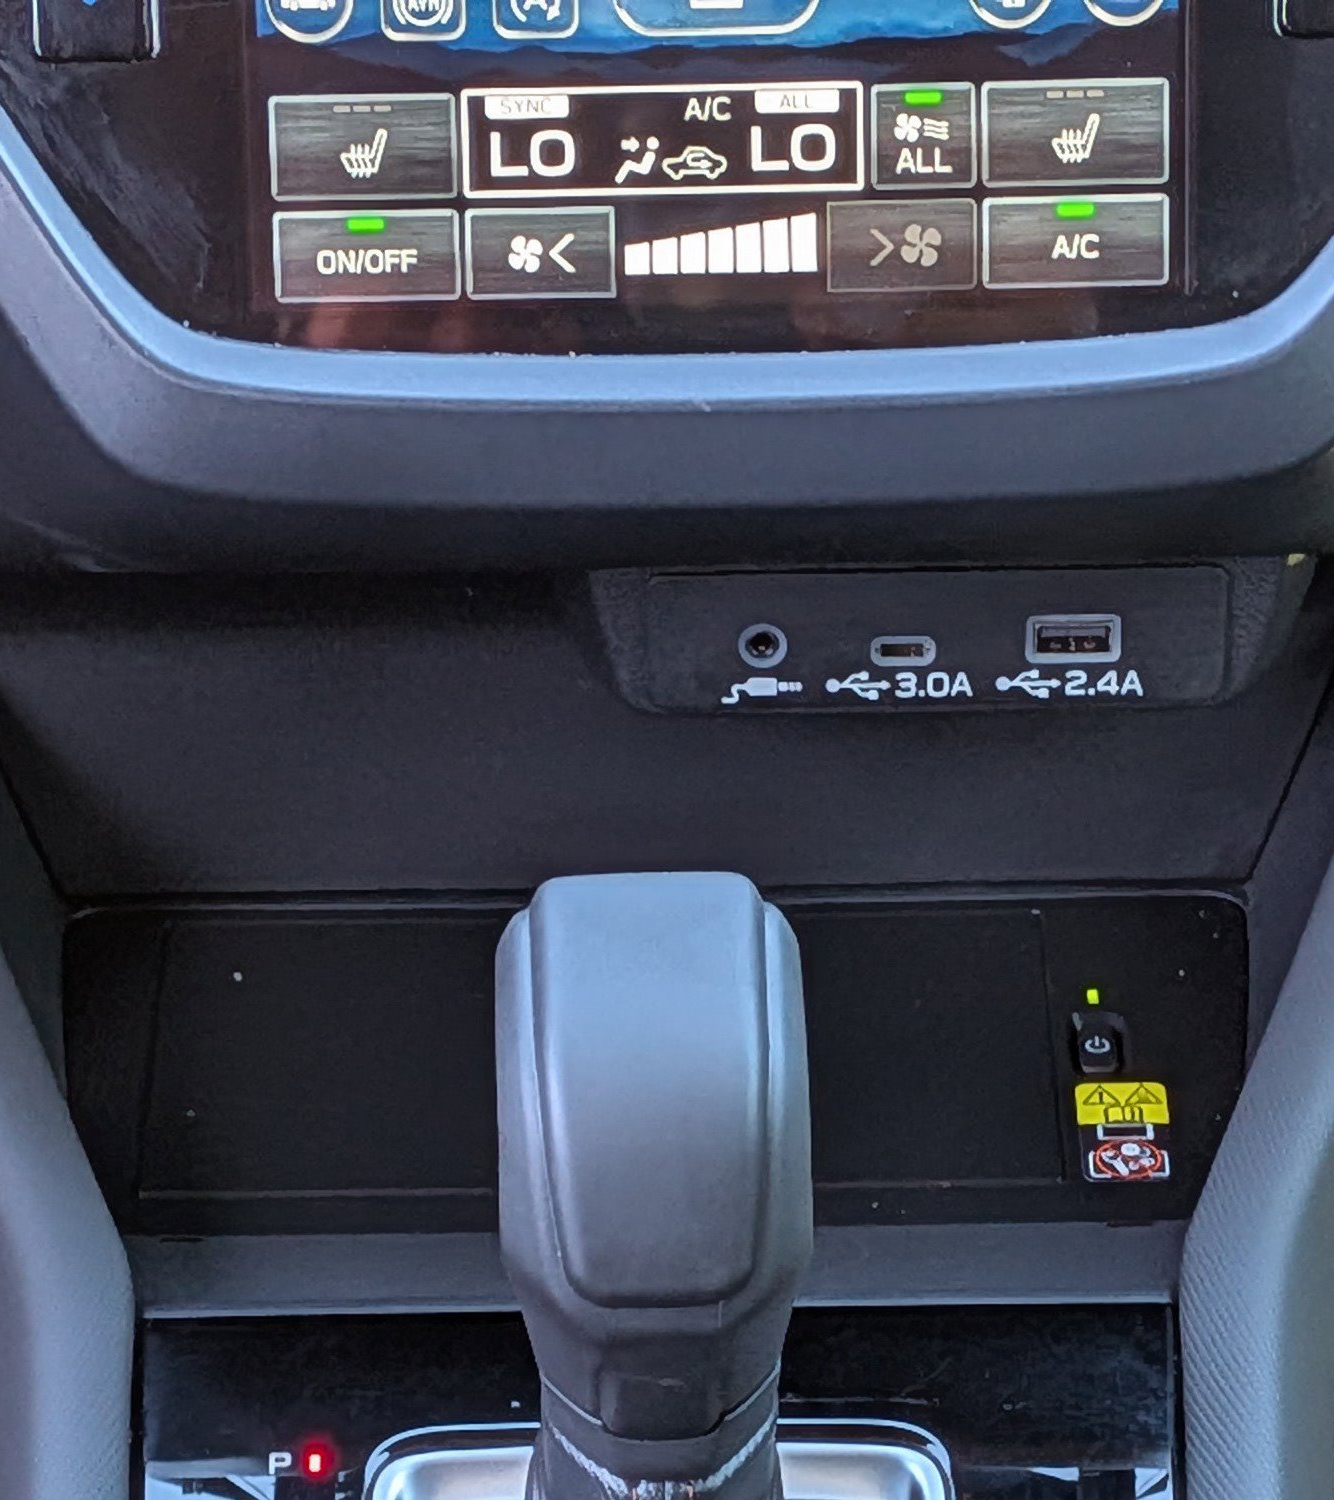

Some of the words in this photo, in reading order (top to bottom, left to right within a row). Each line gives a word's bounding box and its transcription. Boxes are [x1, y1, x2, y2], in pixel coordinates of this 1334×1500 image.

[499, 96, 553, 115] SYNC
[682, 96, 733, 121] A/C
[778, 92, 813, 110] ALL
[489, 129, 576, 177] LO
[750, 123, 837, 172] LO
[895, 147, 952, 174] ALL
[1051, 233, 1100, 260] A/C
[316, 248, 418, 275] ON/OFF
[893, 671, 973, 698] 3.0A
[1065, 669, 1144, 697] 2.4A
[269, 1452, 292, 1474] P
